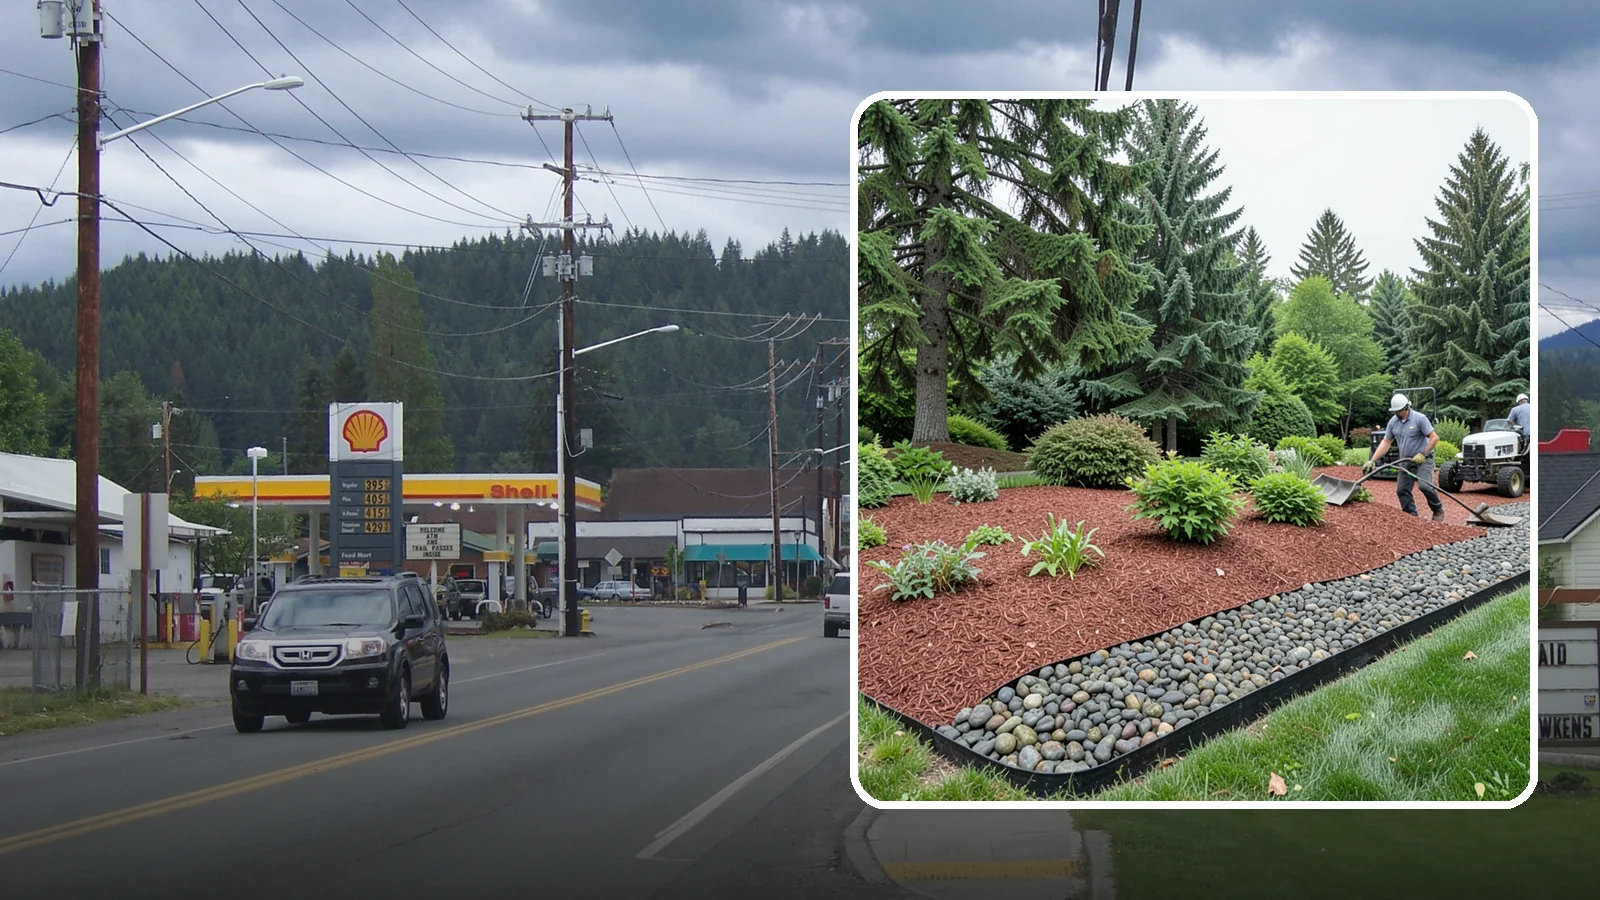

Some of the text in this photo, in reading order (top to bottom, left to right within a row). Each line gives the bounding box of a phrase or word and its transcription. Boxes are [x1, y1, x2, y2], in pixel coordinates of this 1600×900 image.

[366, 479, 384, 490] 395
[490, 484, 547, 499] Shell
[366, 494, 384, 504] 405
[366, 508, 384, 518] 415
[366, 522, 384, 533] 429
